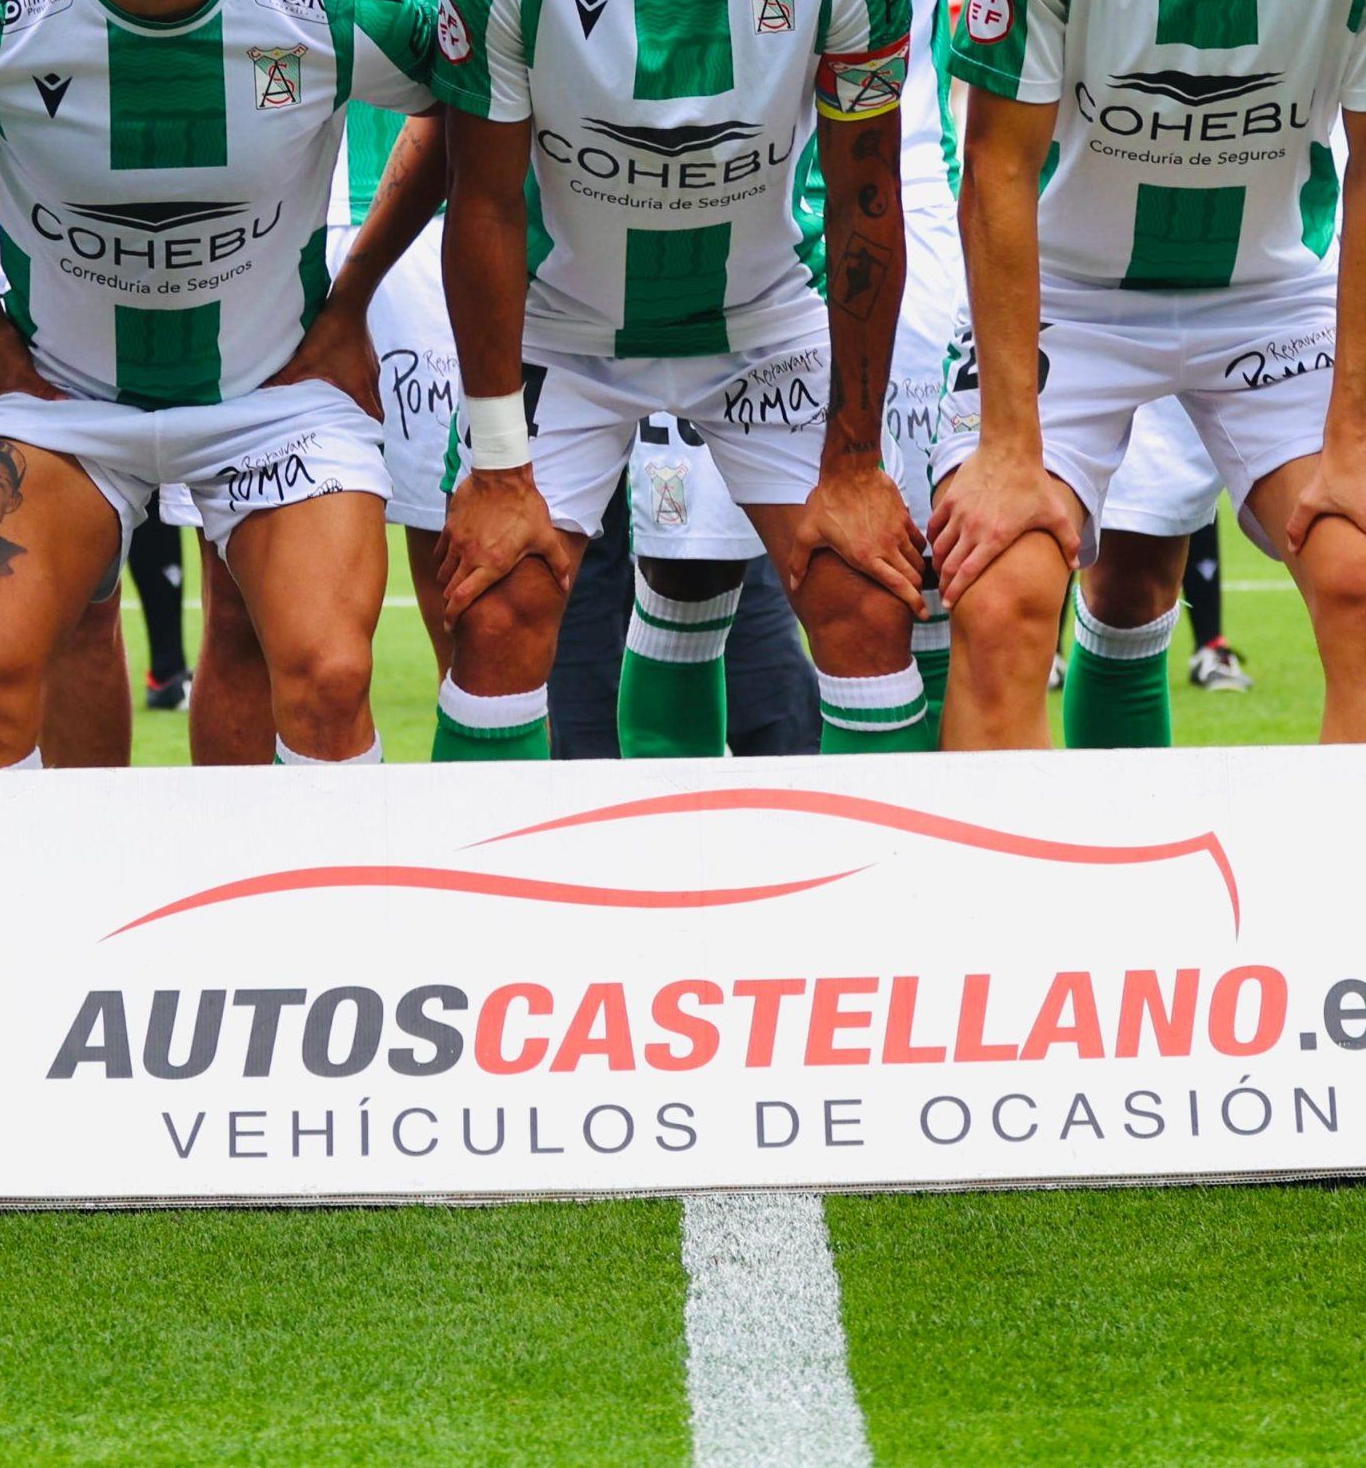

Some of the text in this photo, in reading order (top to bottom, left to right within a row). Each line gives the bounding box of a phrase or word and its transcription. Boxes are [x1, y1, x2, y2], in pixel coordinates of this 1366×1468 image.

[1075, 82, 1316, 141] COHEBU
[537, 124, 797, 189] COHEBU
[1089, 139, 1286, 166] Correduría de Seguros
[569, 179, 767, 211] Correduría de Seguros
[31, 199, 283, 270] COHEBU
[60, 258, 253, 294] Correduría de Seguros
[161, 1074, 1340, 1159] VEHÍCULOS DE OCASIÓN
